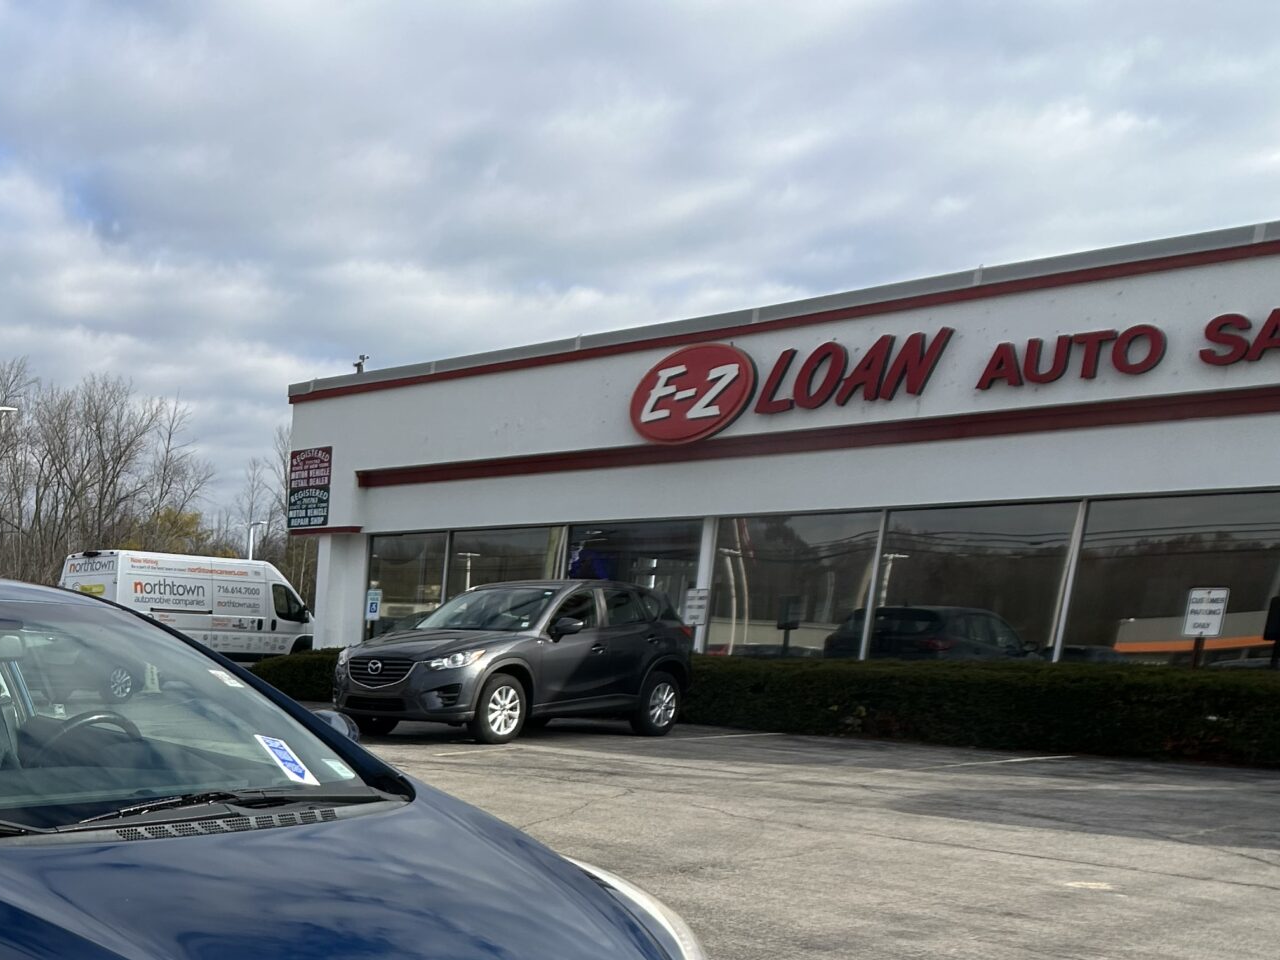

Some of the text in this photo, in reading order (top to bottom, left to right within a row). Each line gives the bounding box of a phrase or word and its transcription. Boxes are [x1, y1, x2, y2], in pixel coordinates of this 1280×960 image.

[640, 362, 740, 424] E-Z
[753, 327, 955, 415] LOAN
[975, 323, 1168, 390] AUTO
[292, 449, 330, 465] REGISTERED
[309, 467, 330, 477] VEHICLE
[309, 476, 329, 486] DEALER
[290, 488, 328, 503] REGISTERED
[307, 507, 327, 517] VEHICLE
[291, 516, 325, 527] REPAIR SHOP
[69, 558, 115, 573] northtown
[133, 579, 205, 597] northtown
[217, 585, 260, 596] 716.614.7000
[134, 595, 205, 607] automotive companies
